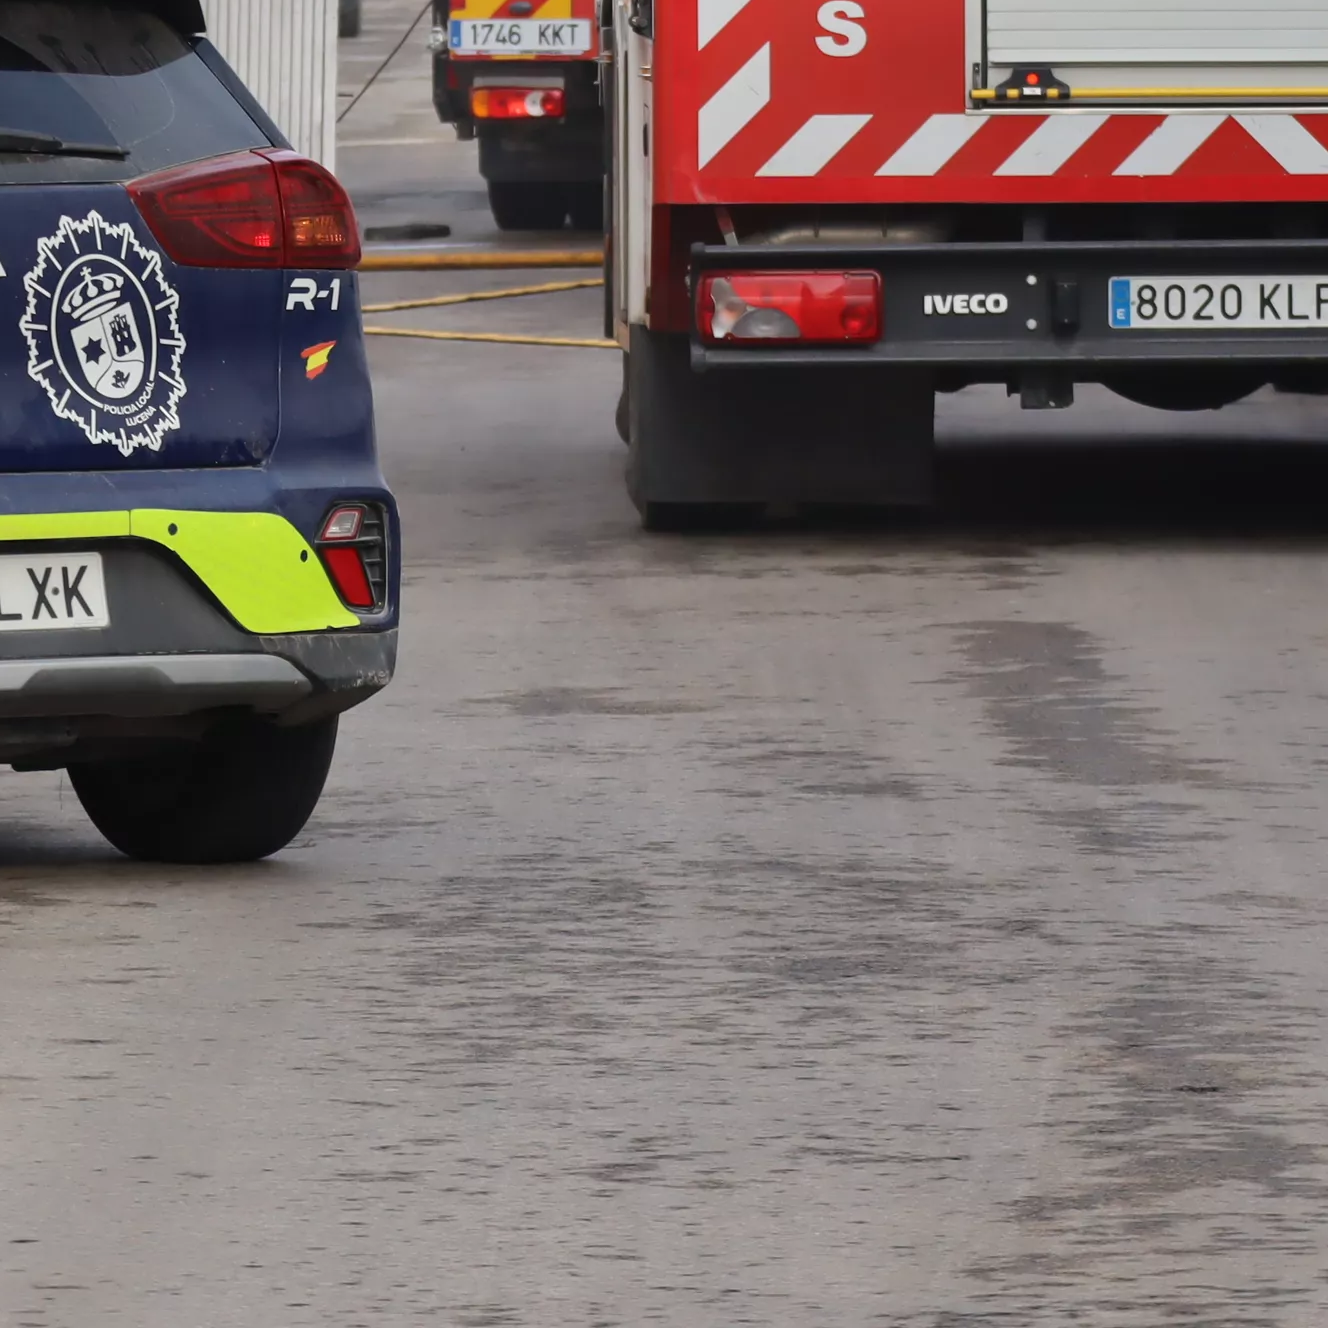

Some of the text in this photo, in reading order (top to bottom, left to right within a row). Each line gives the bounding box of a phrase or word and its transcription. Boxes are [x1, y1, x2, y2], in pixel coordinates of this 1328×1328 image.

[471, 24, 579, 46] 1746 KKT
[285, 278, 340, 311] R-1
[923, 293, 1009, 315] IVECO
[1135, 283, 1243, 321] 8020
[104, 382, 155, 415] POLICIA LOCAL
[125, 405, 157, 426] LUCENA
